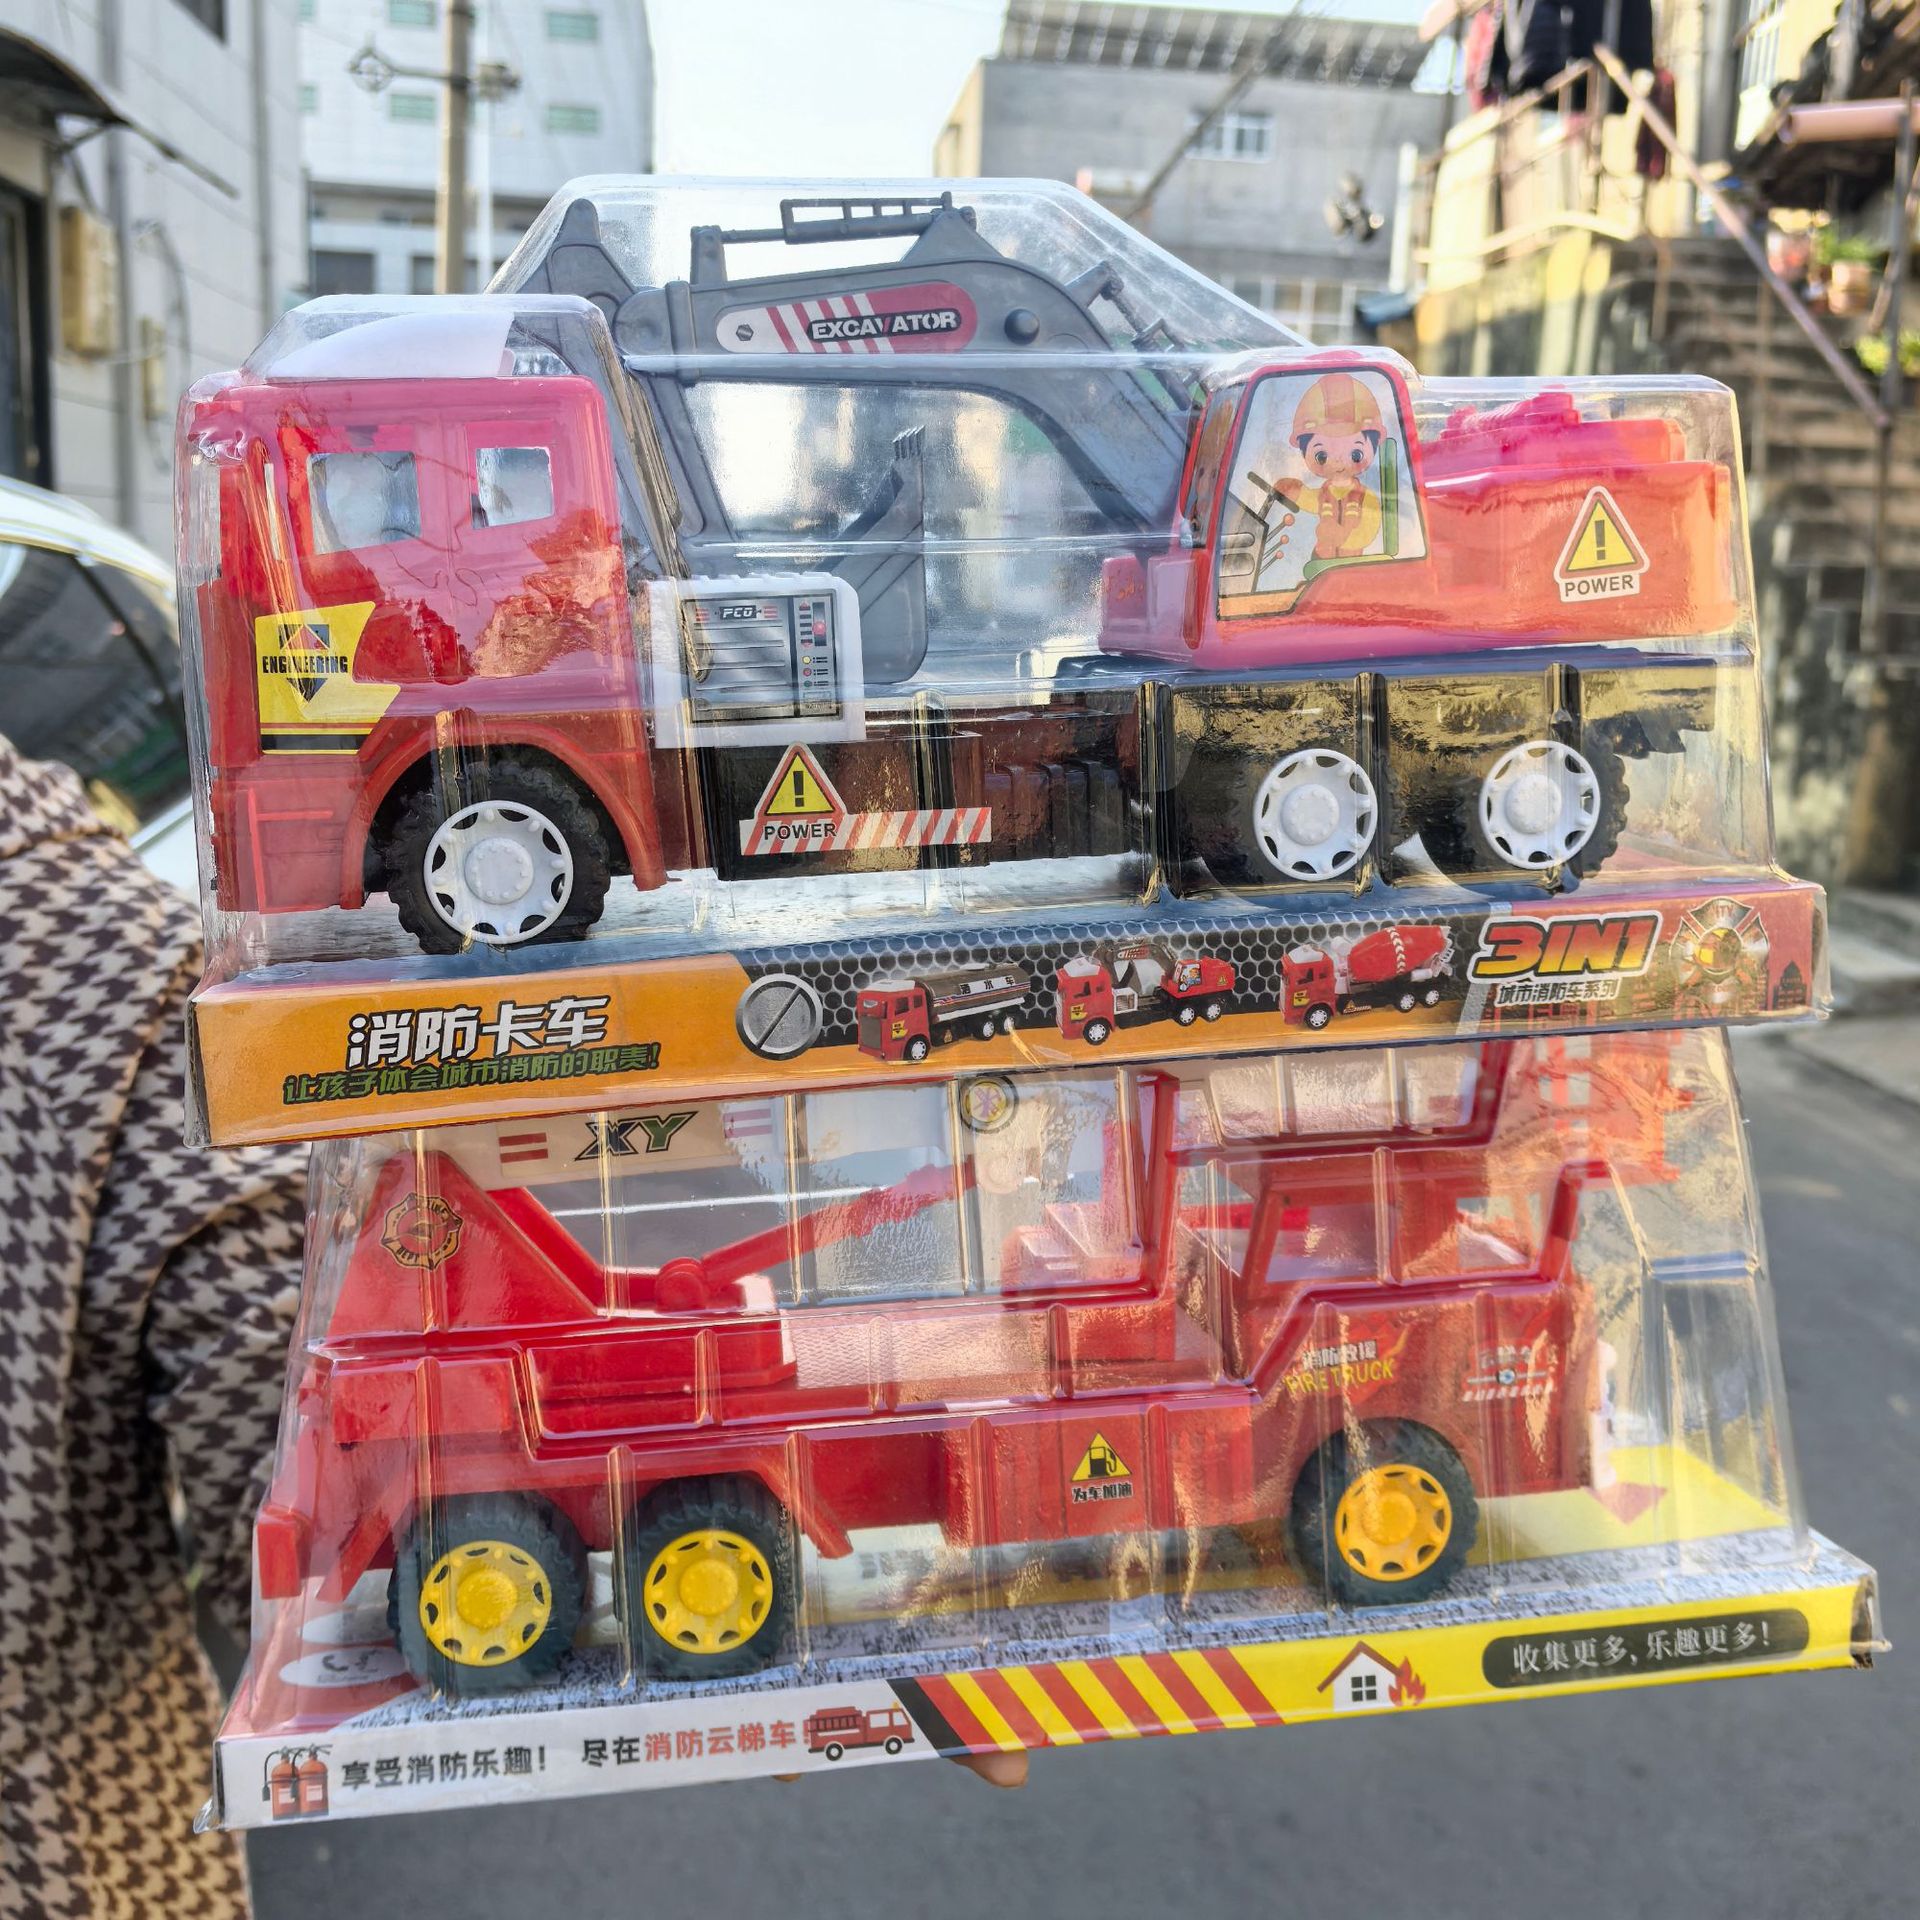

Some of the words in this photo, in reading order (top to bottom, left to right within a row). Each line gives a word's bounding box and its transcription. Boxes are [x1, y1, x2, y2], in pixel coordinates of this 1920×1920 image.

[811, 311, 958, 340] EXCAVATOR
[1564, 574, 1634, 597] POWER
[262, 656, 348, 674] ENGINEERING
[763, 823, 838, 840] POWER
[1498, 980, 1618, 1005] 城市消防车系列
[347, 997, 609, 1067] 消防卡车
[341, 1744, 546, 1790] 享受消防乐趣！
